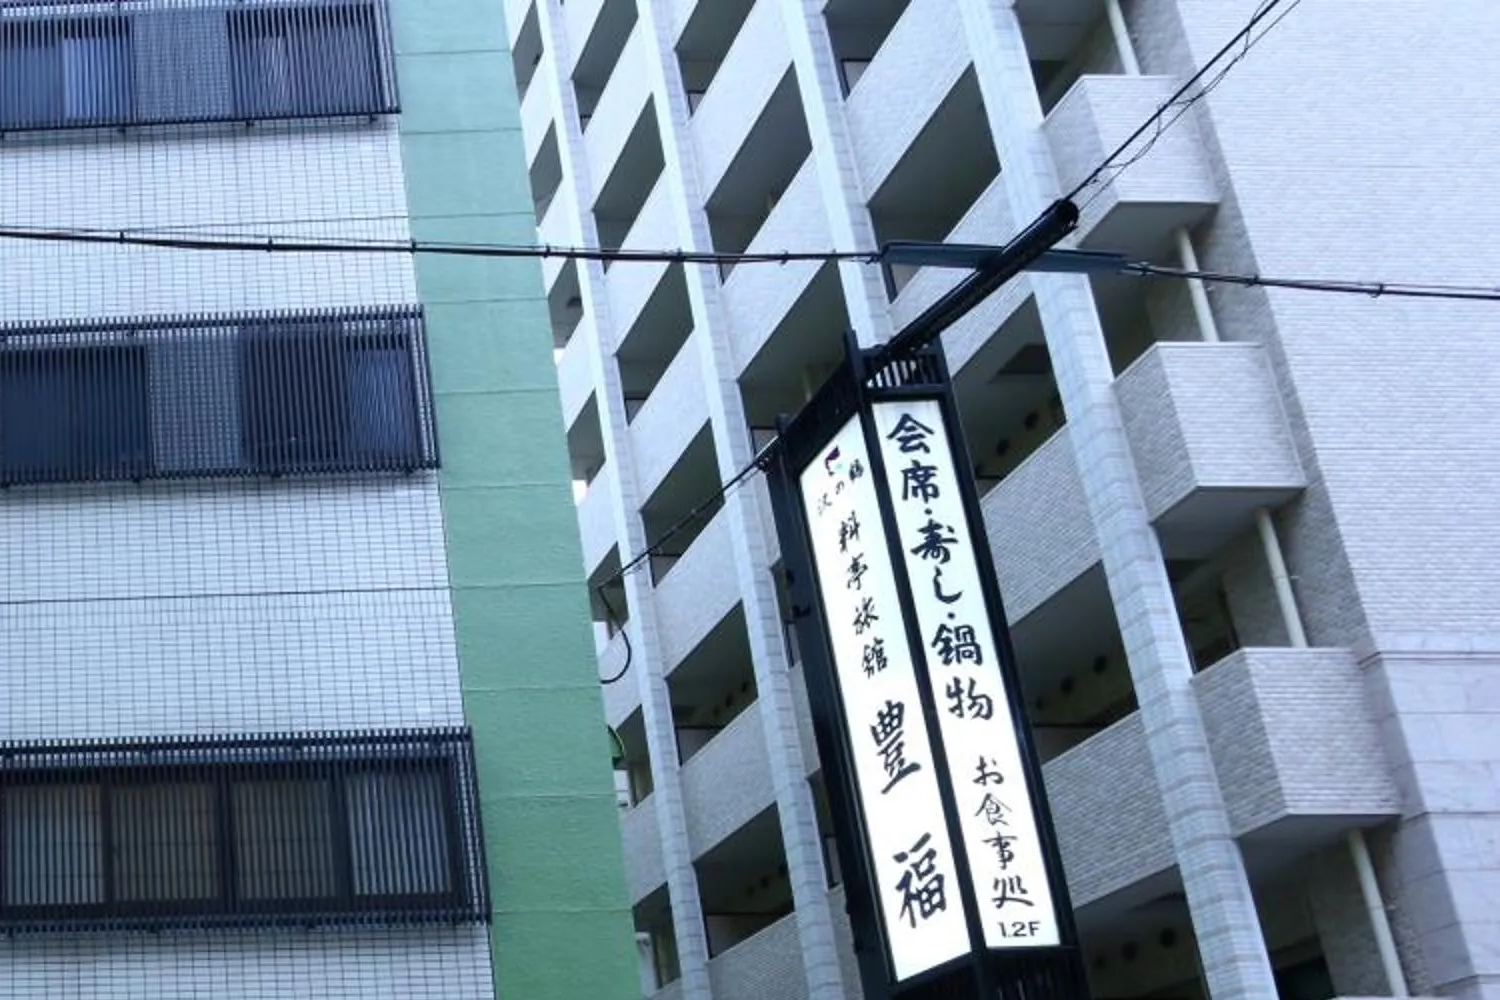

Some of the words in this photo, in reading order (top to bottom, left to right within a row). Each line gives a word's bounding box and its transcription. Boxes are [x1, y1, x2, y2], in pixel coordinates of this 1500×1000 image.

[838, 513, 887, 679] 料亭旅館
[972, 757, 1035, 908] お食事処
